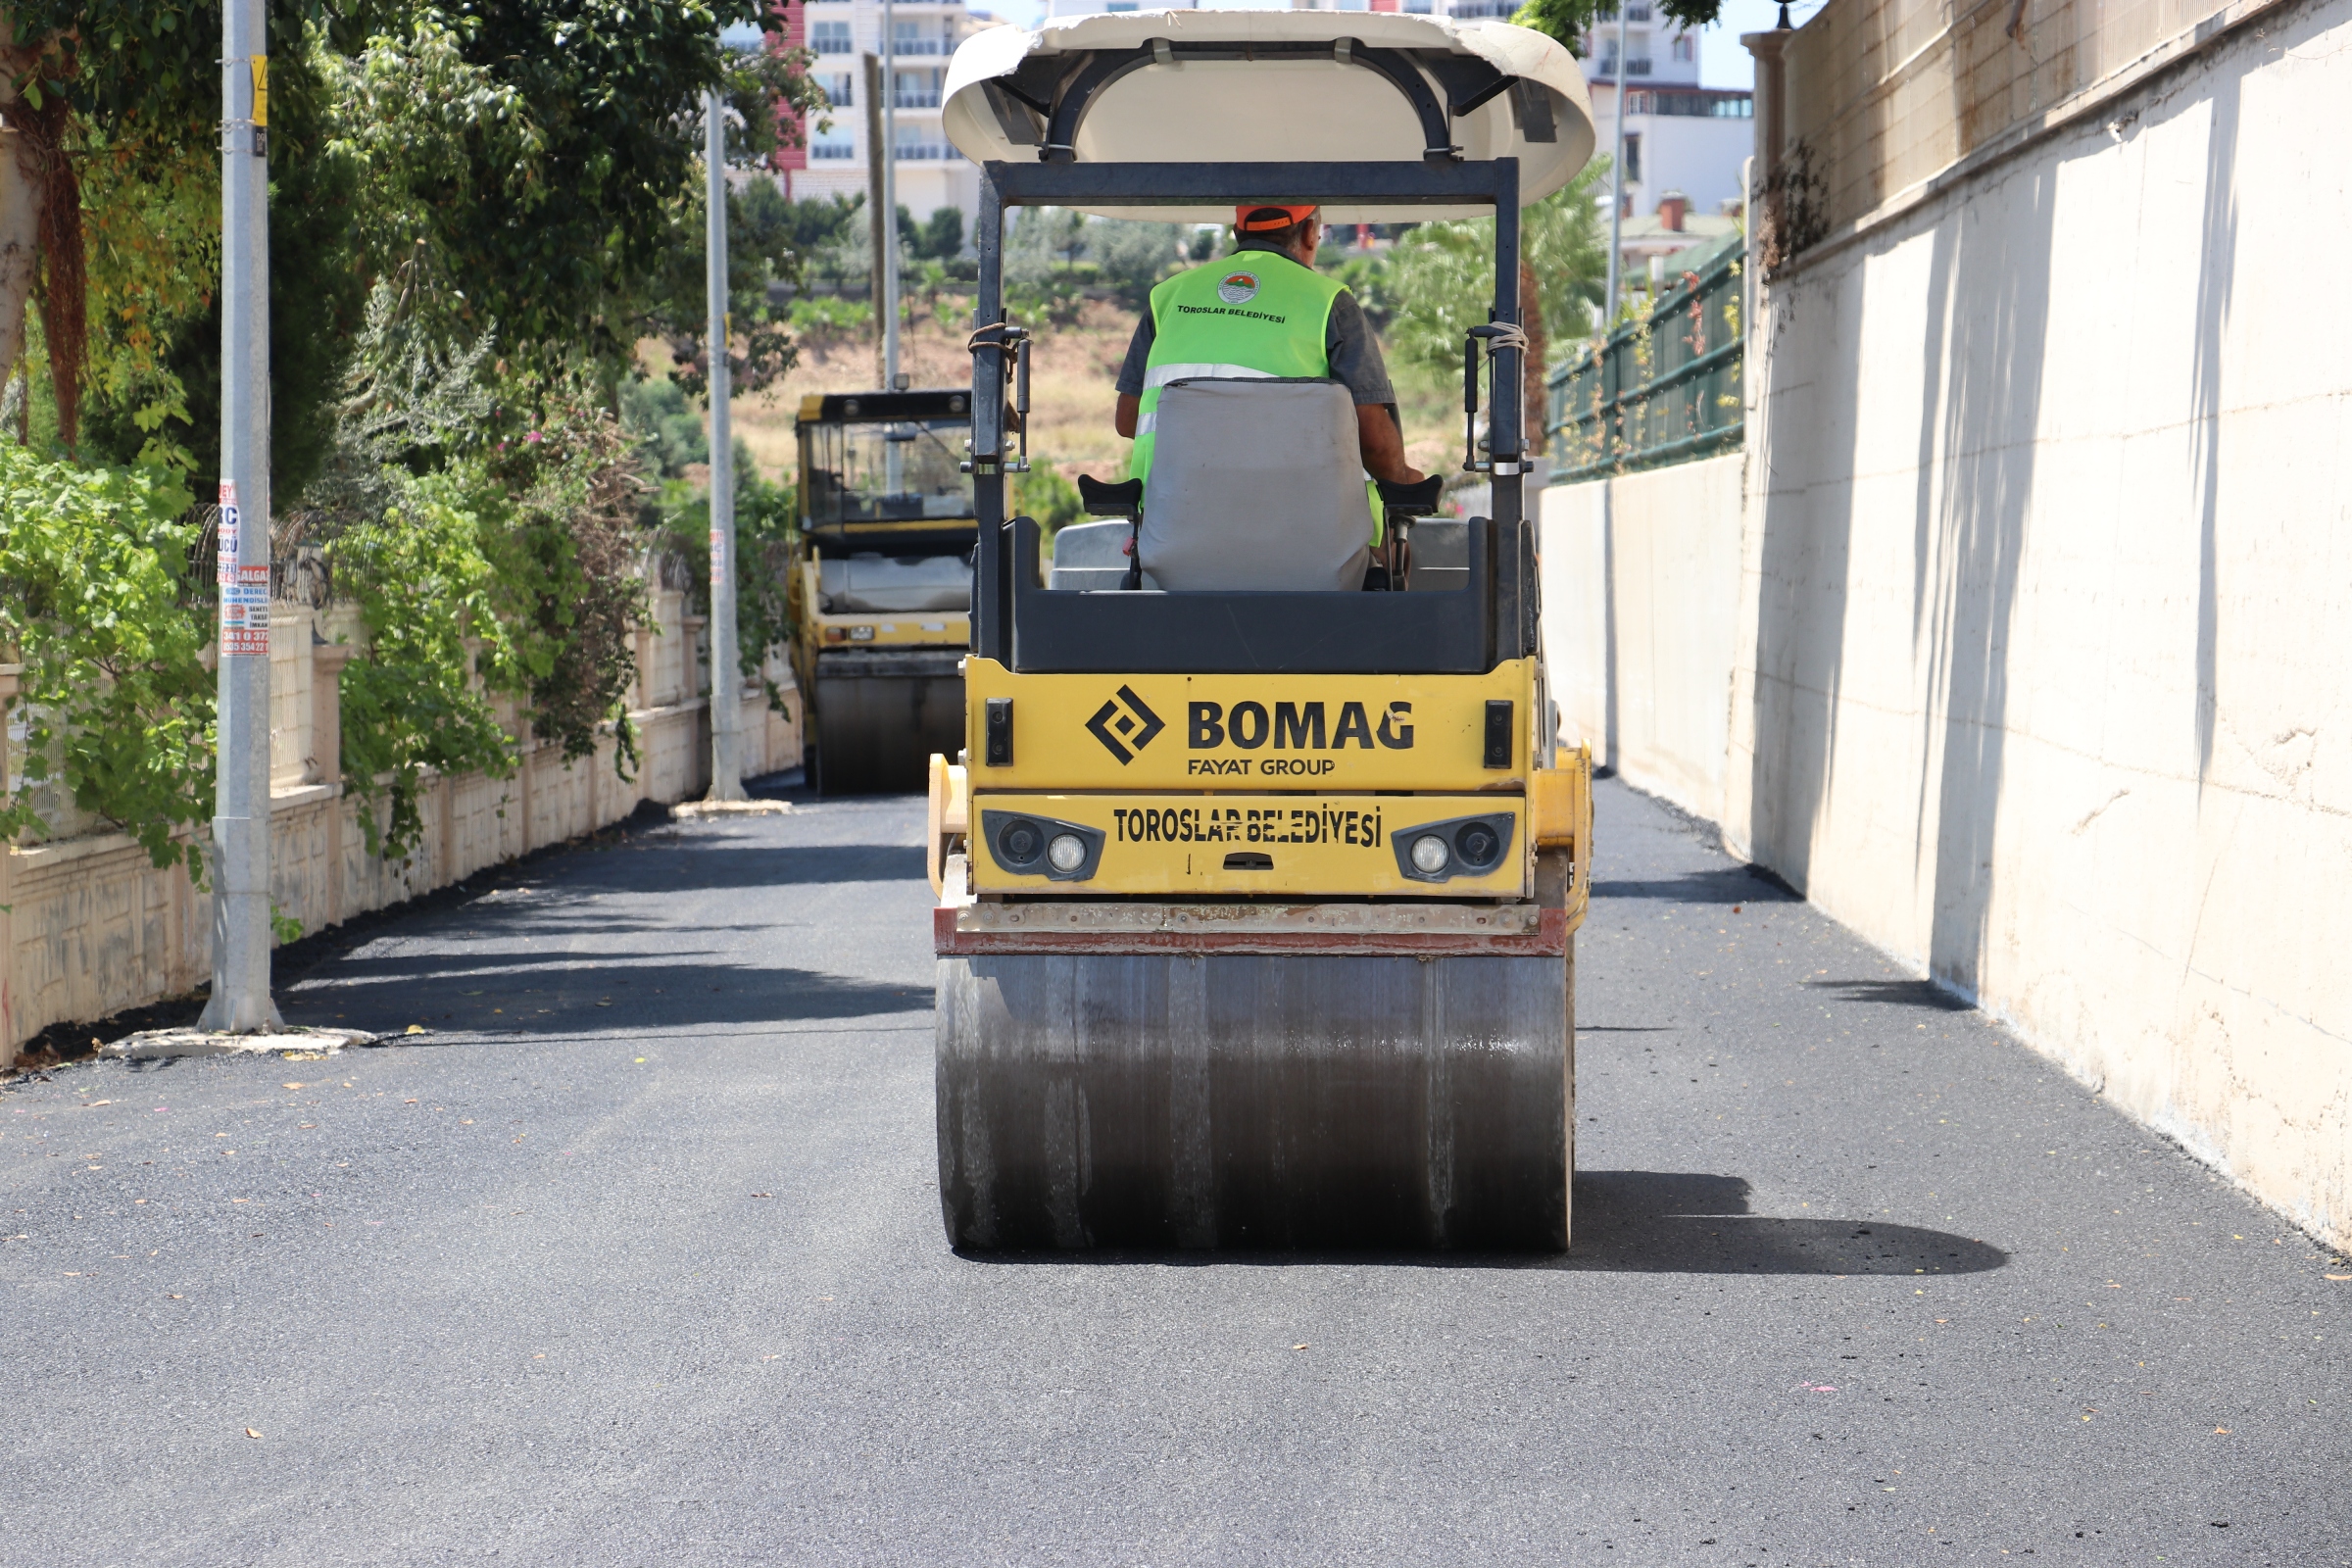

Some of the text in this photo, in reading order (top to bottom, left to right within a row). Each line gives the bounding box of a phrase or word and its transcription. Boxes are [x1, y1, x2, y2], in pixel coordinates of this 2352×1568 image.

[1177, 305, 1286, 324] TOROSLAR BELEDİYESİ
[1188, 701, 1414, 750] BOMAG
[1188, 760, 1335, 775] FAYAT GROUP
[1113, 803, 1382, 848] TOROSLAR BELEDİYESİ
